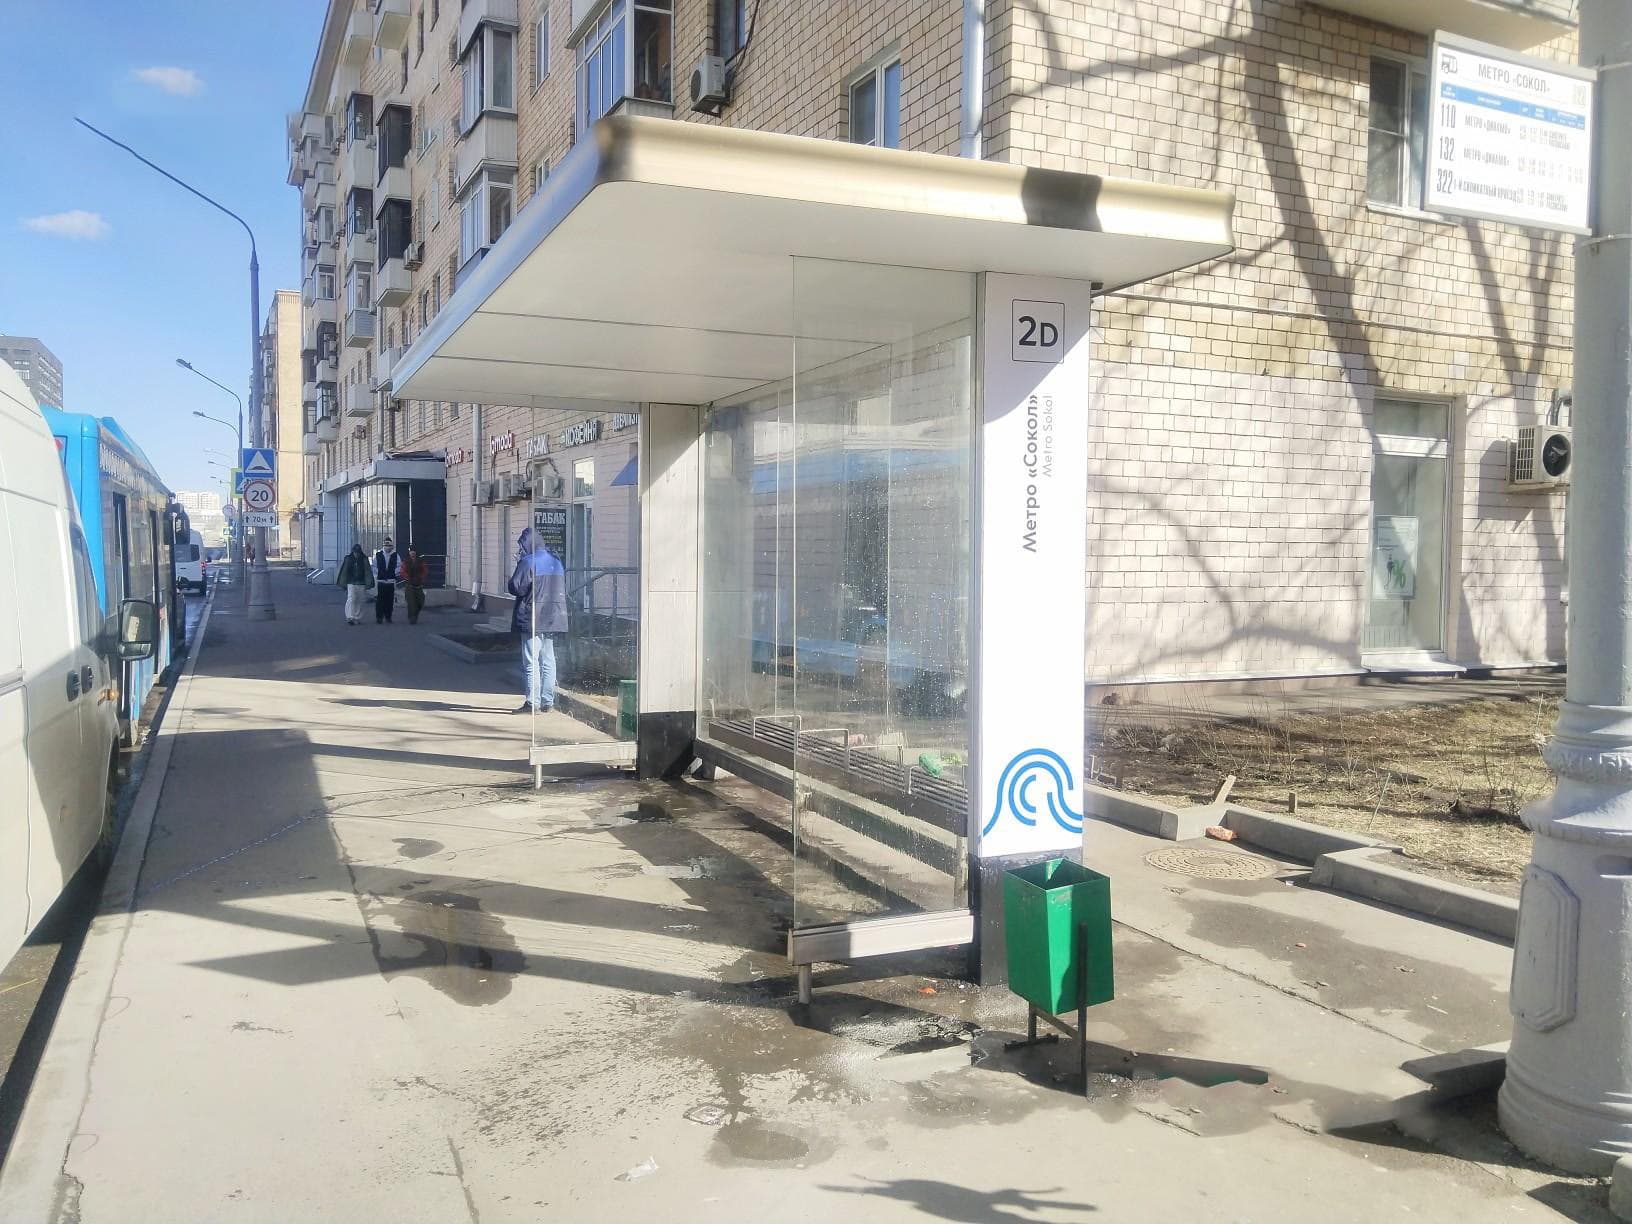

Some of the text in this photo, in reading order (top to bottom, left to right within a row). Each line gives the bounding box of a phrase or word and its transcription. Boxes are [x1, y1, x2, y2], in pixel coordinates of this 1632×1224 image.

[1478, 63, 1510, 84] МЕТРО
[1441, 104, 1457, 129] 110
[1465, 114, 1483, 129] МЕТРО
[1439, 135, 1455, 162] 132
[1463, 147, 1481, 162] МЕТРО
[1436, 168, 1453, 194] 322
[1018, 315, 1059, 347] 2D
[565, 419, 599, 446] КОФЕЙНЯ
[1042, 395, 1053, 478] Metro Sokol
[526, 433, 550, 458] ТАБАК
[1022, 394, 1040, 553] Метро «Сокол»
[251, 490, 268, 502] 20
[534, 511, 566, 525] ТАБАК
